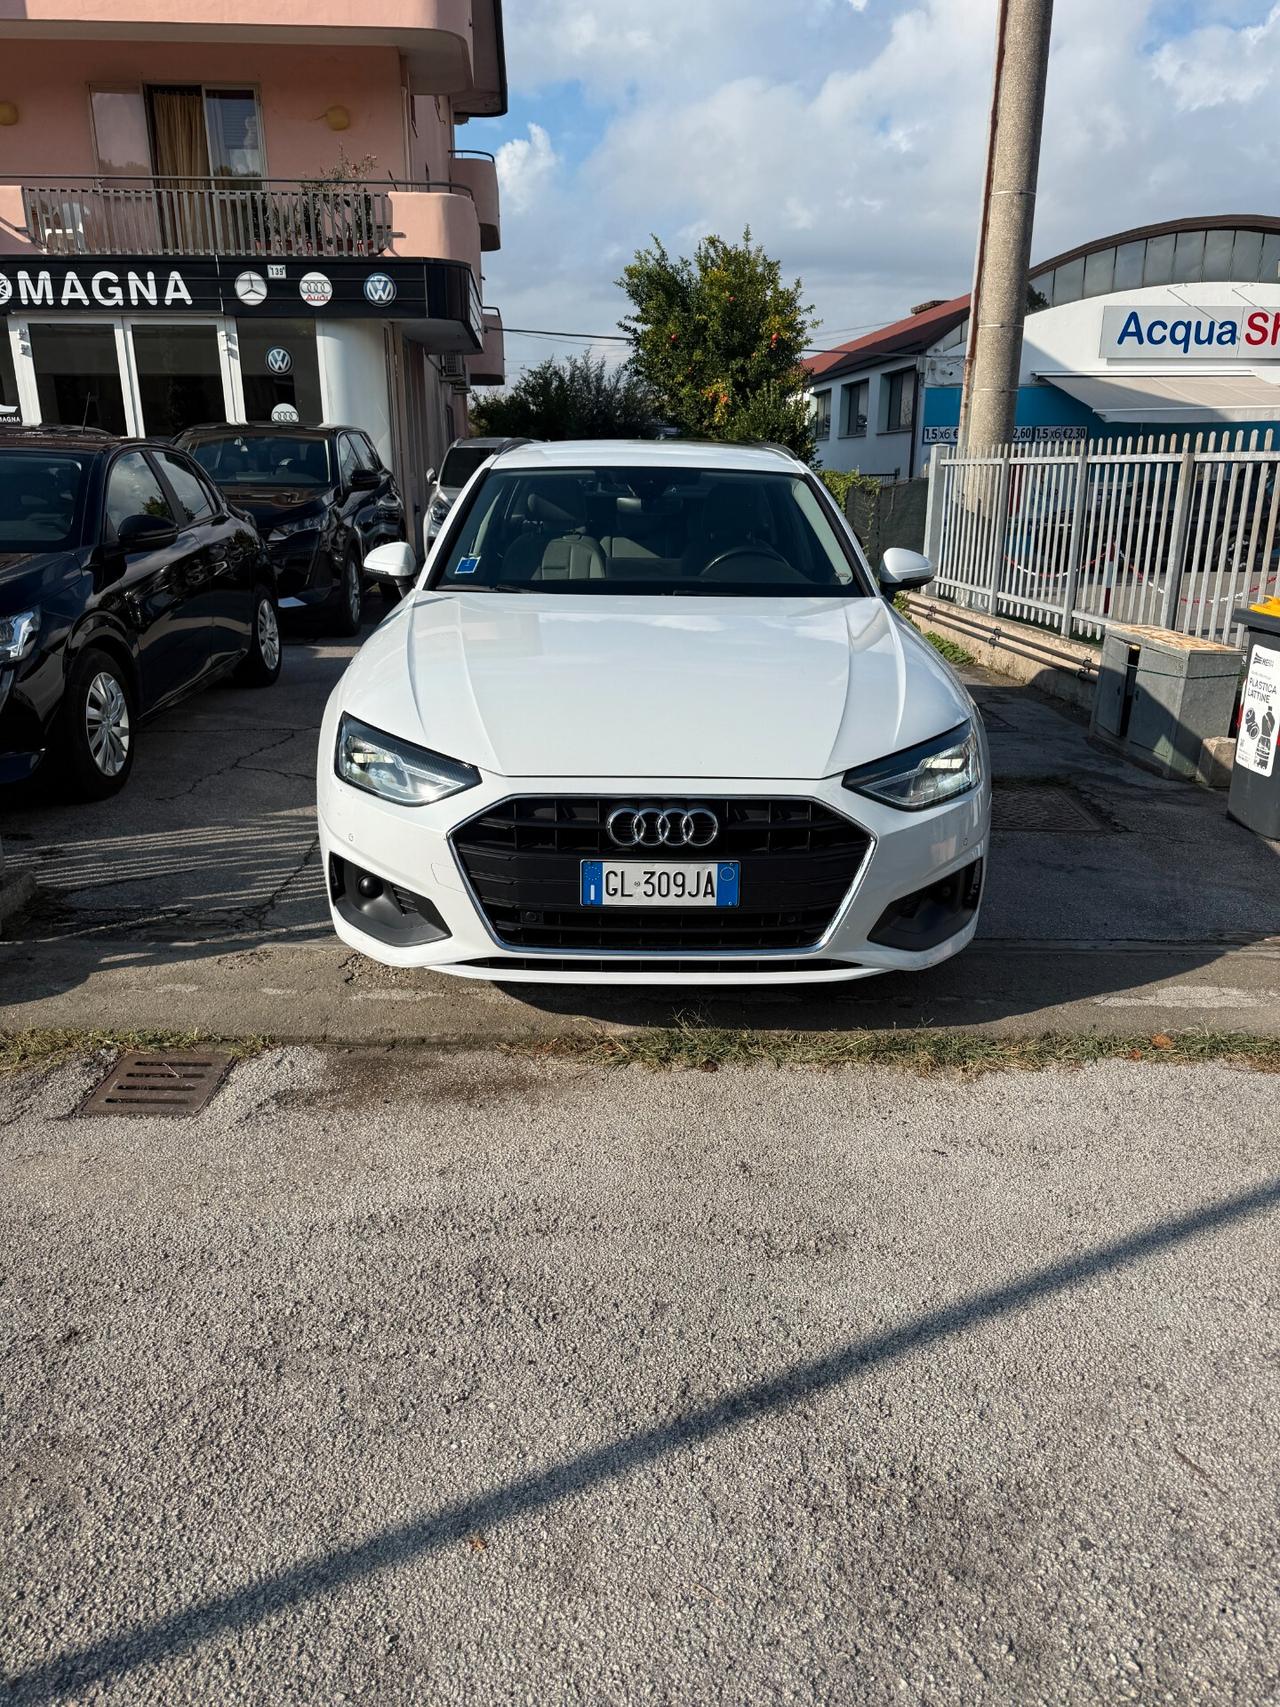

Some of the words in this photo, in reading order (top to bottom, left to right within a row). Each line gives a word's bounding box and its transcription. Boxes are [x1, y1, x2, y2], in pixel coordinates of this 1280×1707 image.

[305, 294, 329, 302] Audi
[1117, 311, 1237, 354] Acqua
[1249, 677, 1277, 695] PLASTICA
[1248, 687, 1271, 704] LATTINE
